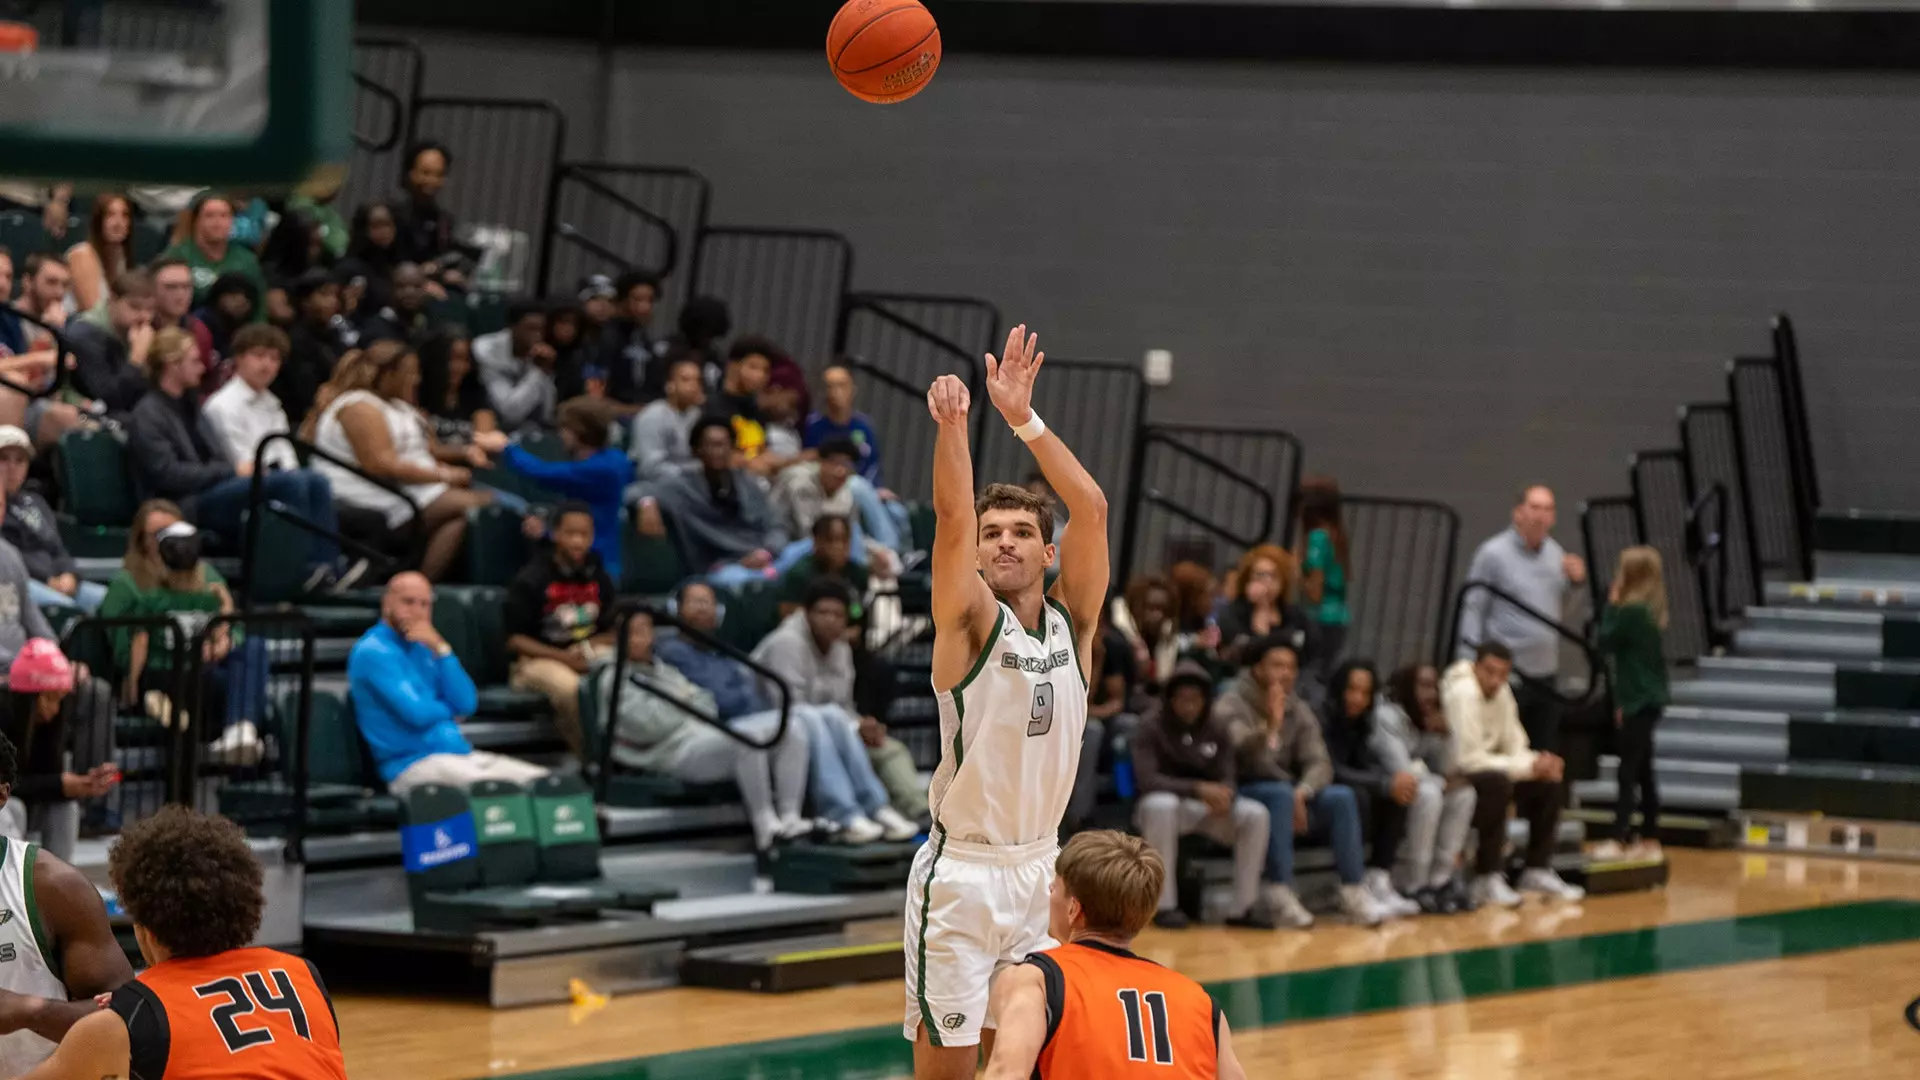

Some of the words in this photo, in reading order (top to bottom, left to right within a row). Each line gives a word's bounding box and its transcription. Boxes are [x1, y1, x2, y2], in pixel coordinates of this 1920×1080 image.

[1027, 682, 1054, 737] 9
[192, 968, 313, 1054] 24
[1117, 988, 1174, 1065] 11
